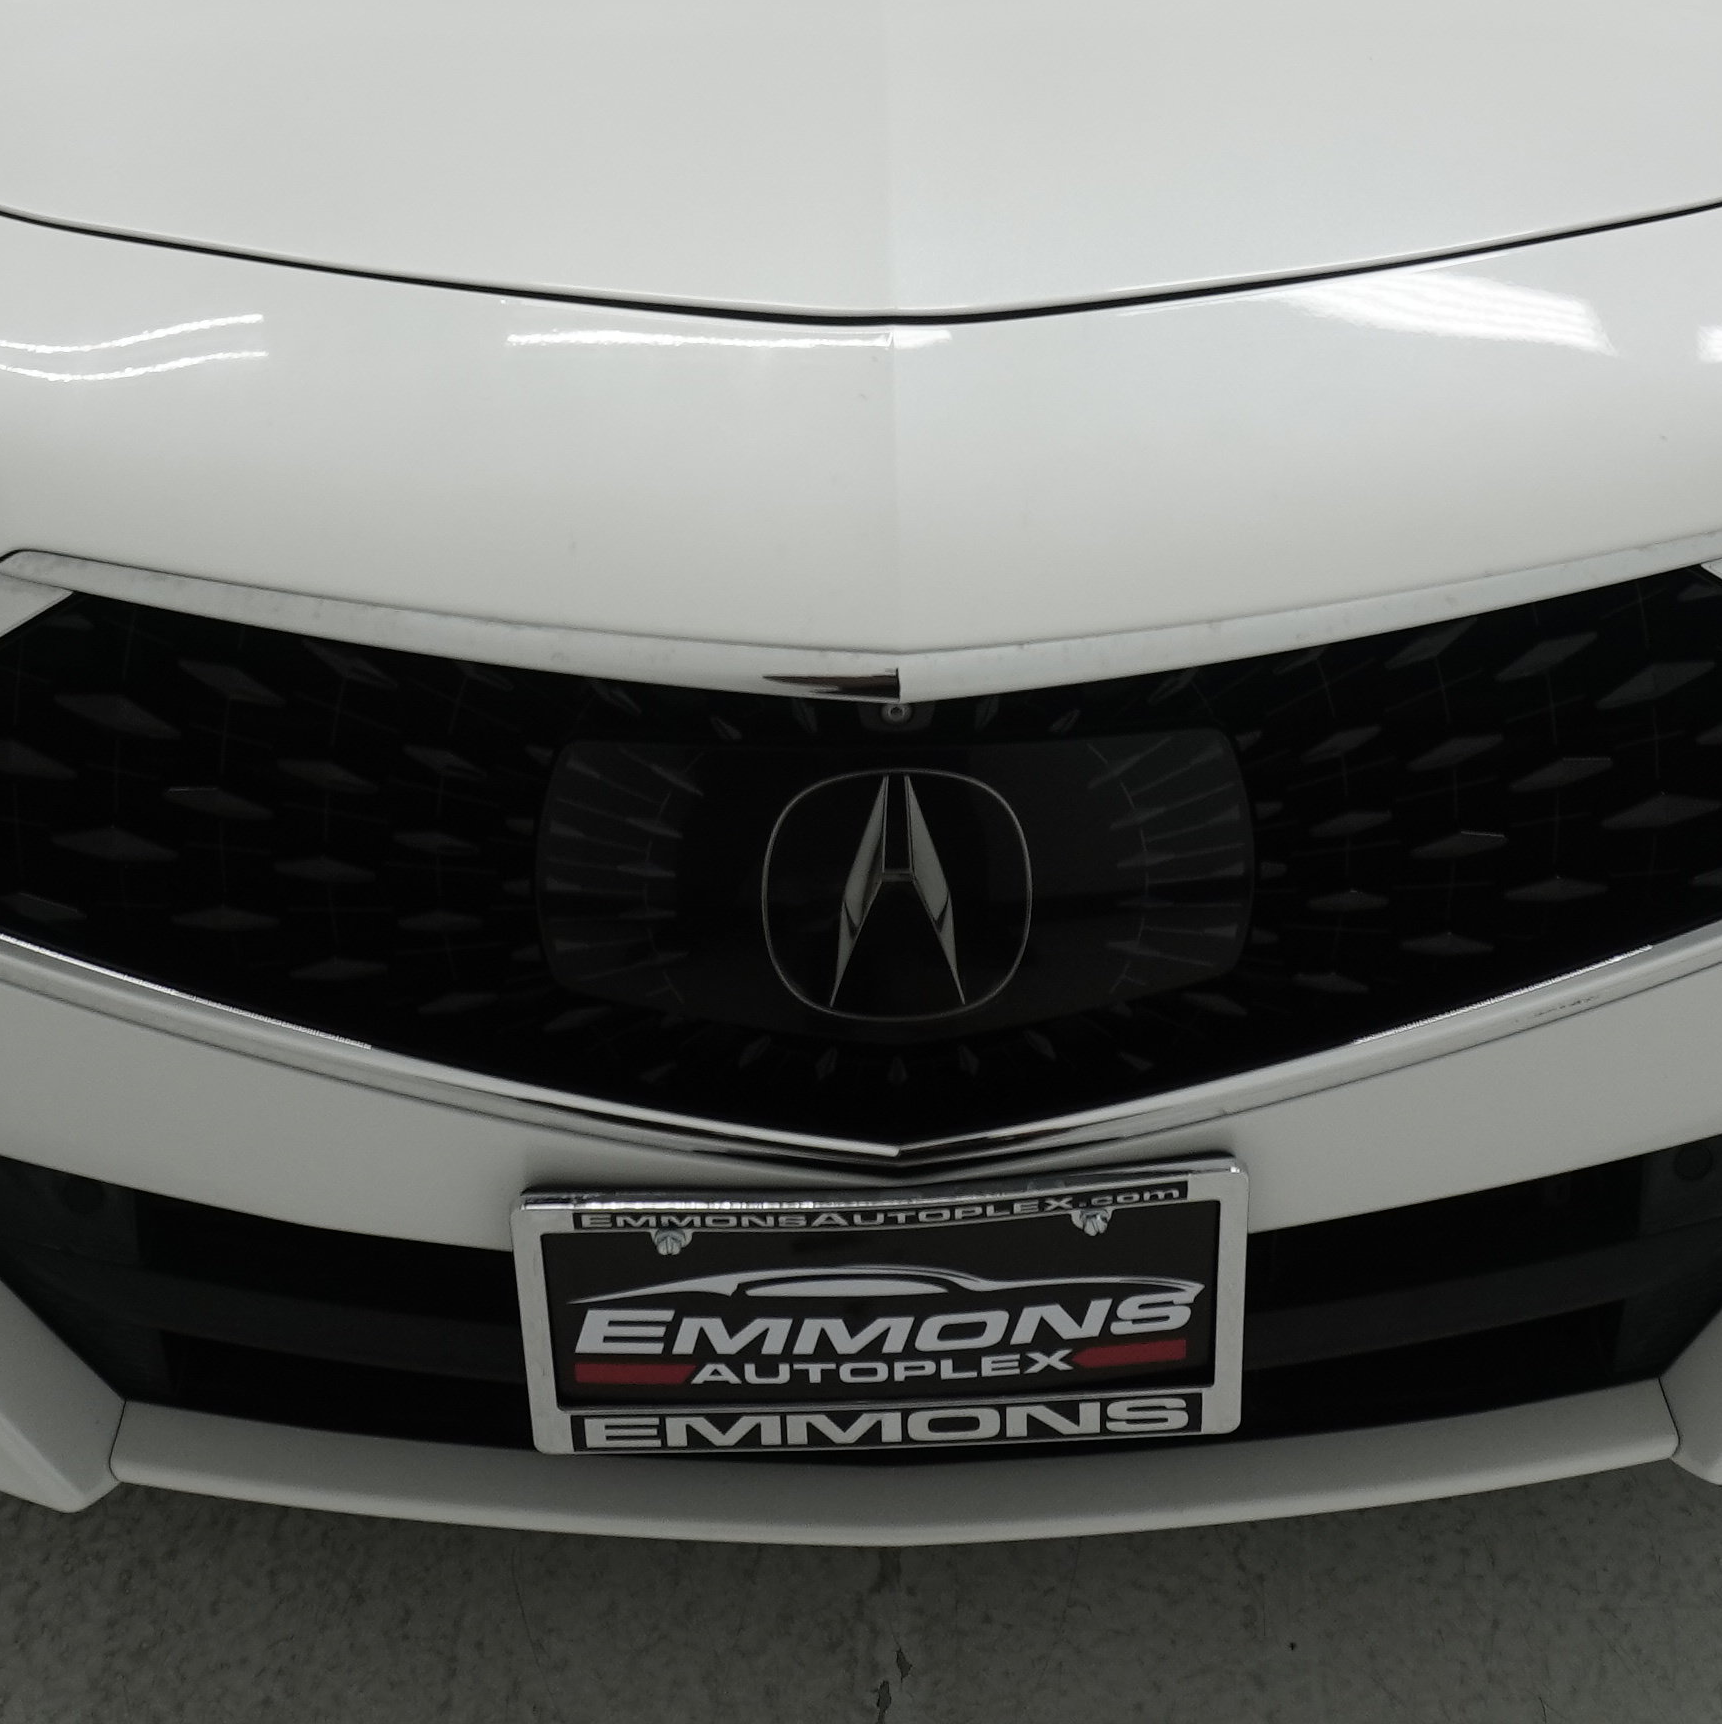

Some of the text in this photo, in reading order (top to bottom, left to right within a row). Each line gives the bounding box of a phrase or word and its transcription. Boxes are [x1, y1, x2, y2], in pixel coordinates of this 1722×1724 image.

[575, 1291, 1193, 1355] EMMONS
[691, 1349, 1073, 1384] AUTOPLEX
[584, 1398, 1189, 1448] EMMONS
